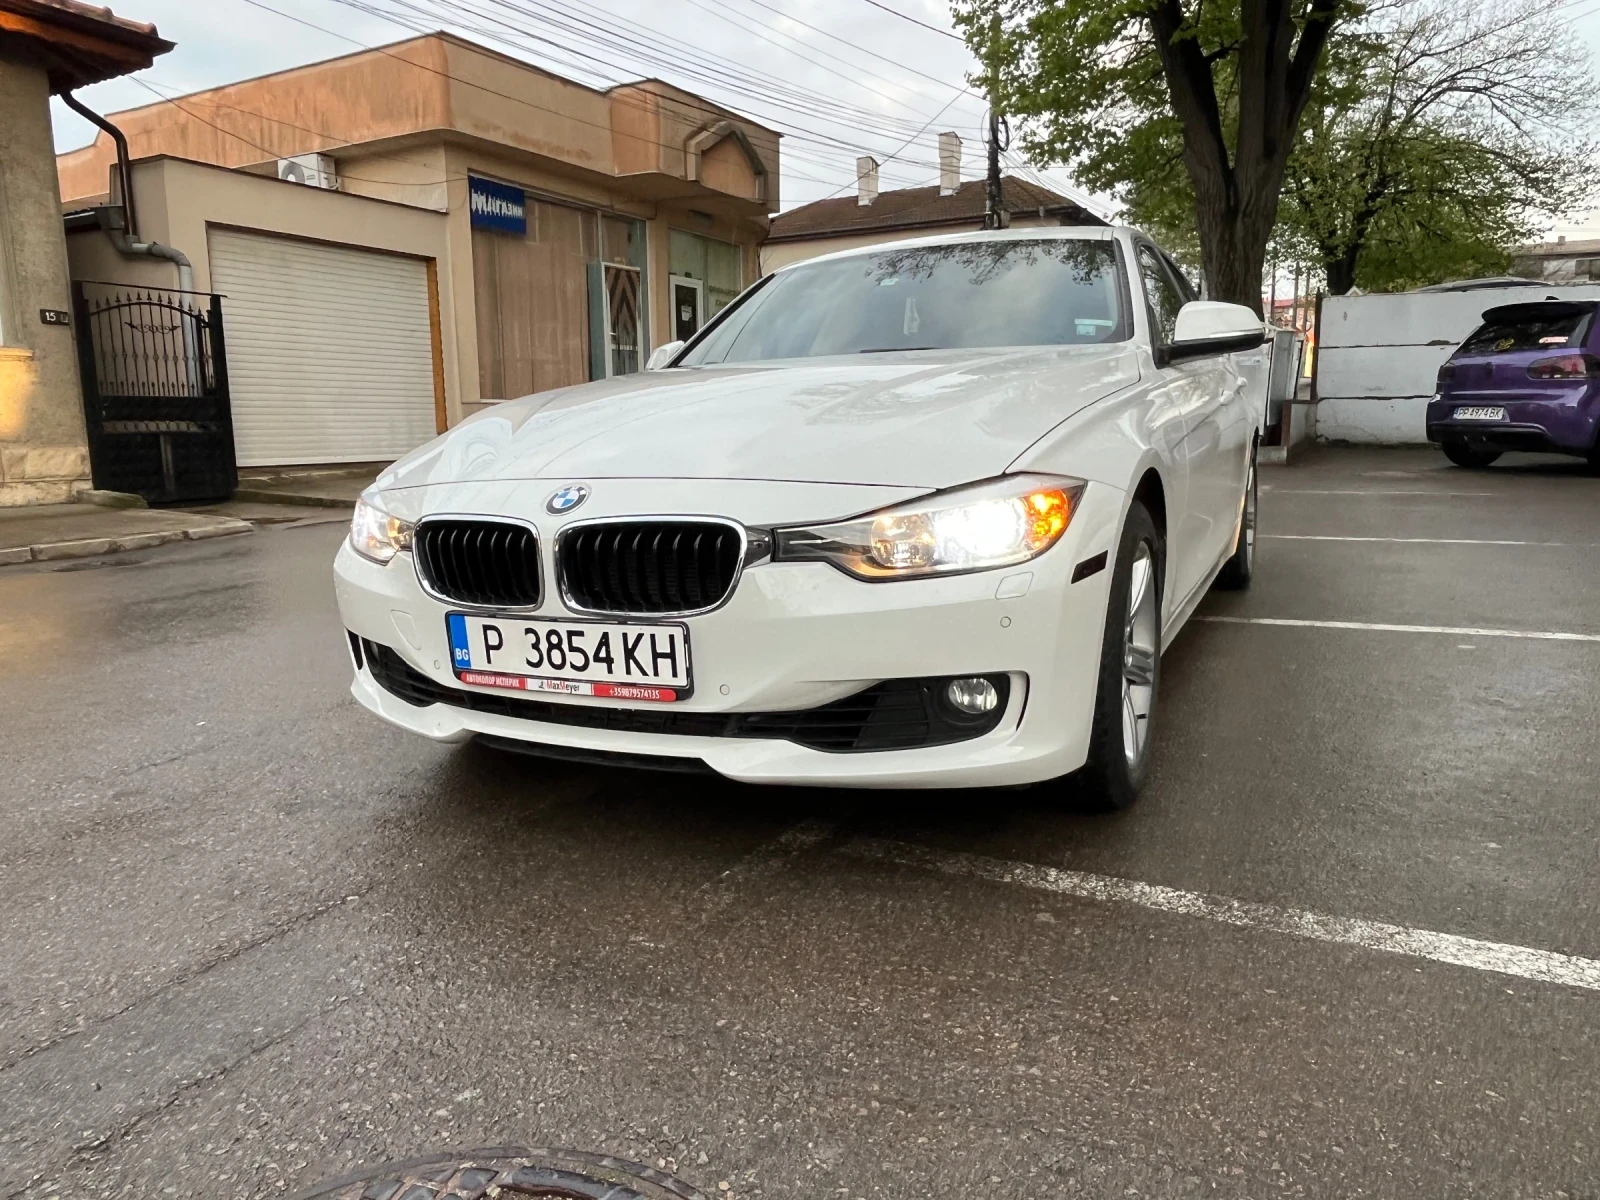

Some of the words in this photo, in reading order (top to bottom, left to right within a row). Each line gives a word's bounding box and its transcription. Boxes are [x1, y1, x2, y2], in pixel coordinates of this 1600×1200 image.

[45, 312, 56, 321] 15
[482, 624, 503, 665] P
[455, 648, 469, 661] BG
[547, 680, 580, 694] MaxMeyer
